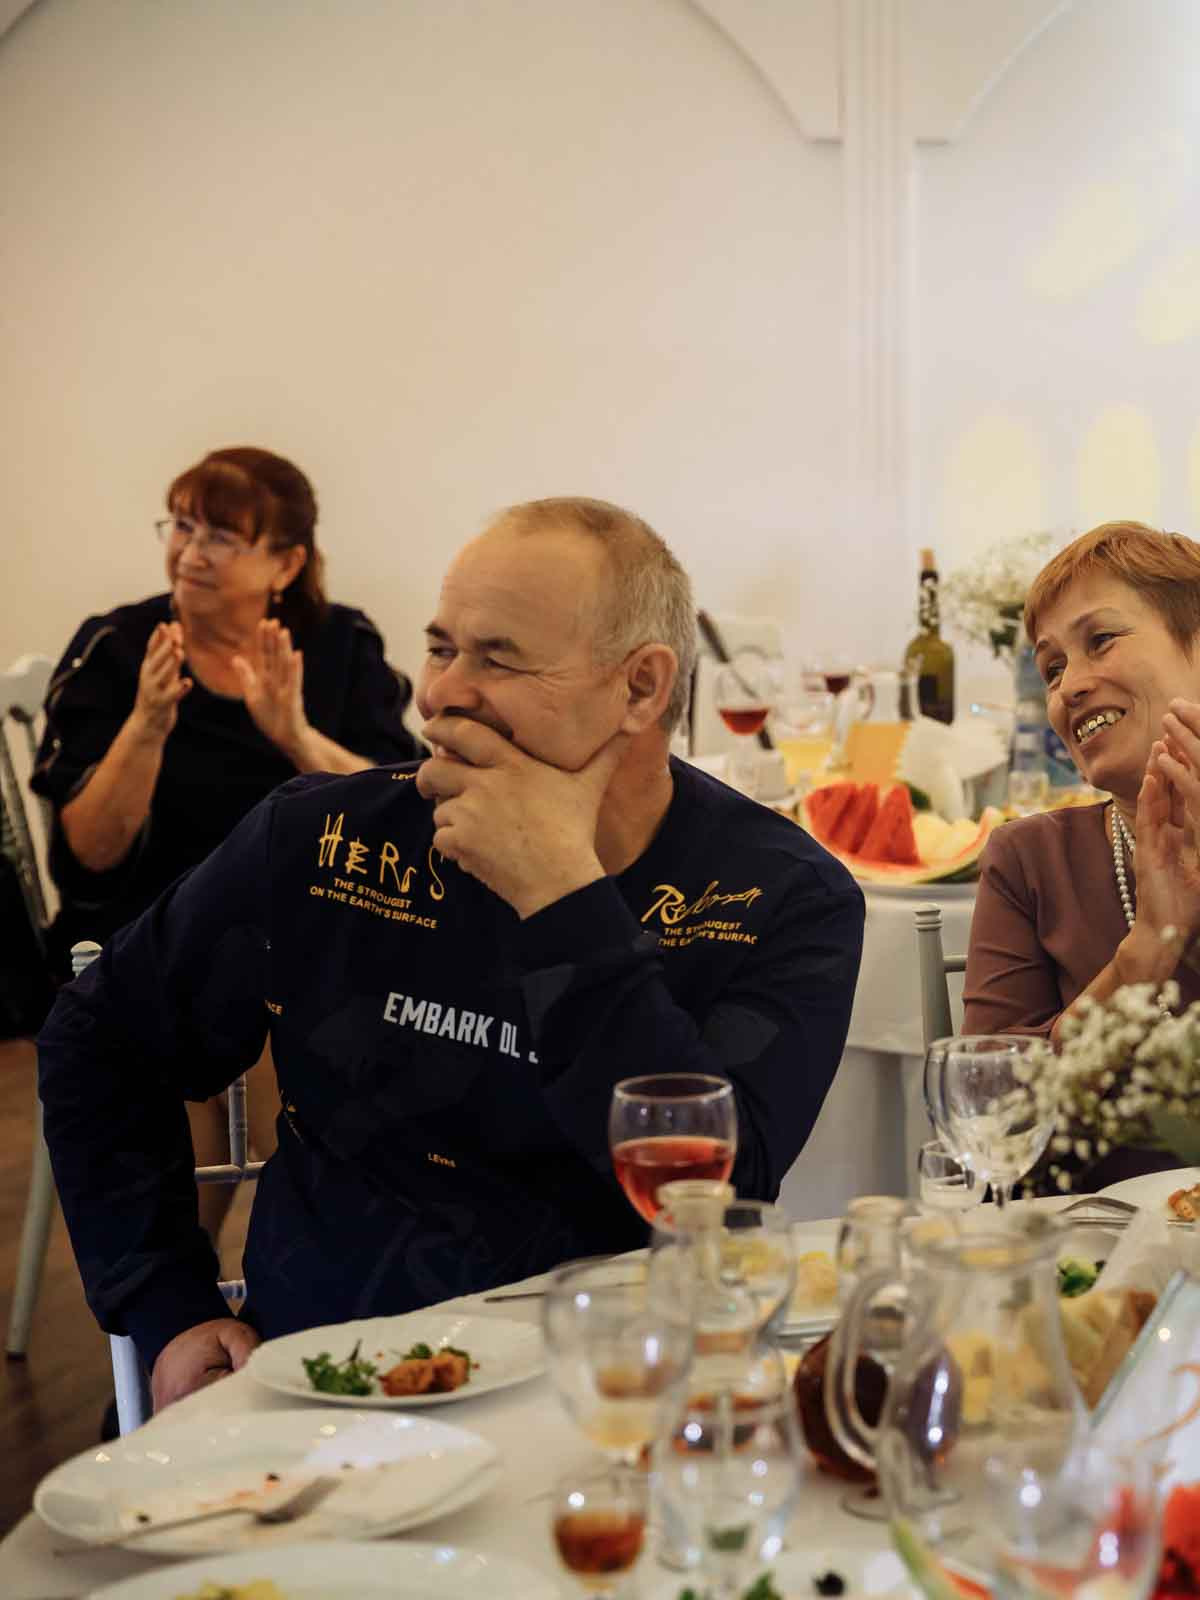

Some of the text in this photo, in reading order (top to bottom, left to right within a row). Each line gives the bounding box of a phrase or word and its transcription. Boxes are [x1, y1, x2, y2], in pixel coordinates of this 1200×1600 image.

[334, 878, 355, 892] THE
[309, 885, 325, 897] ON
[327, 890, 348, 903] THE
[391, 911, 438, 929] SURFACE
[664, 927, 682, 936] THE
[383, 991, 495, 1048] EMBARK
